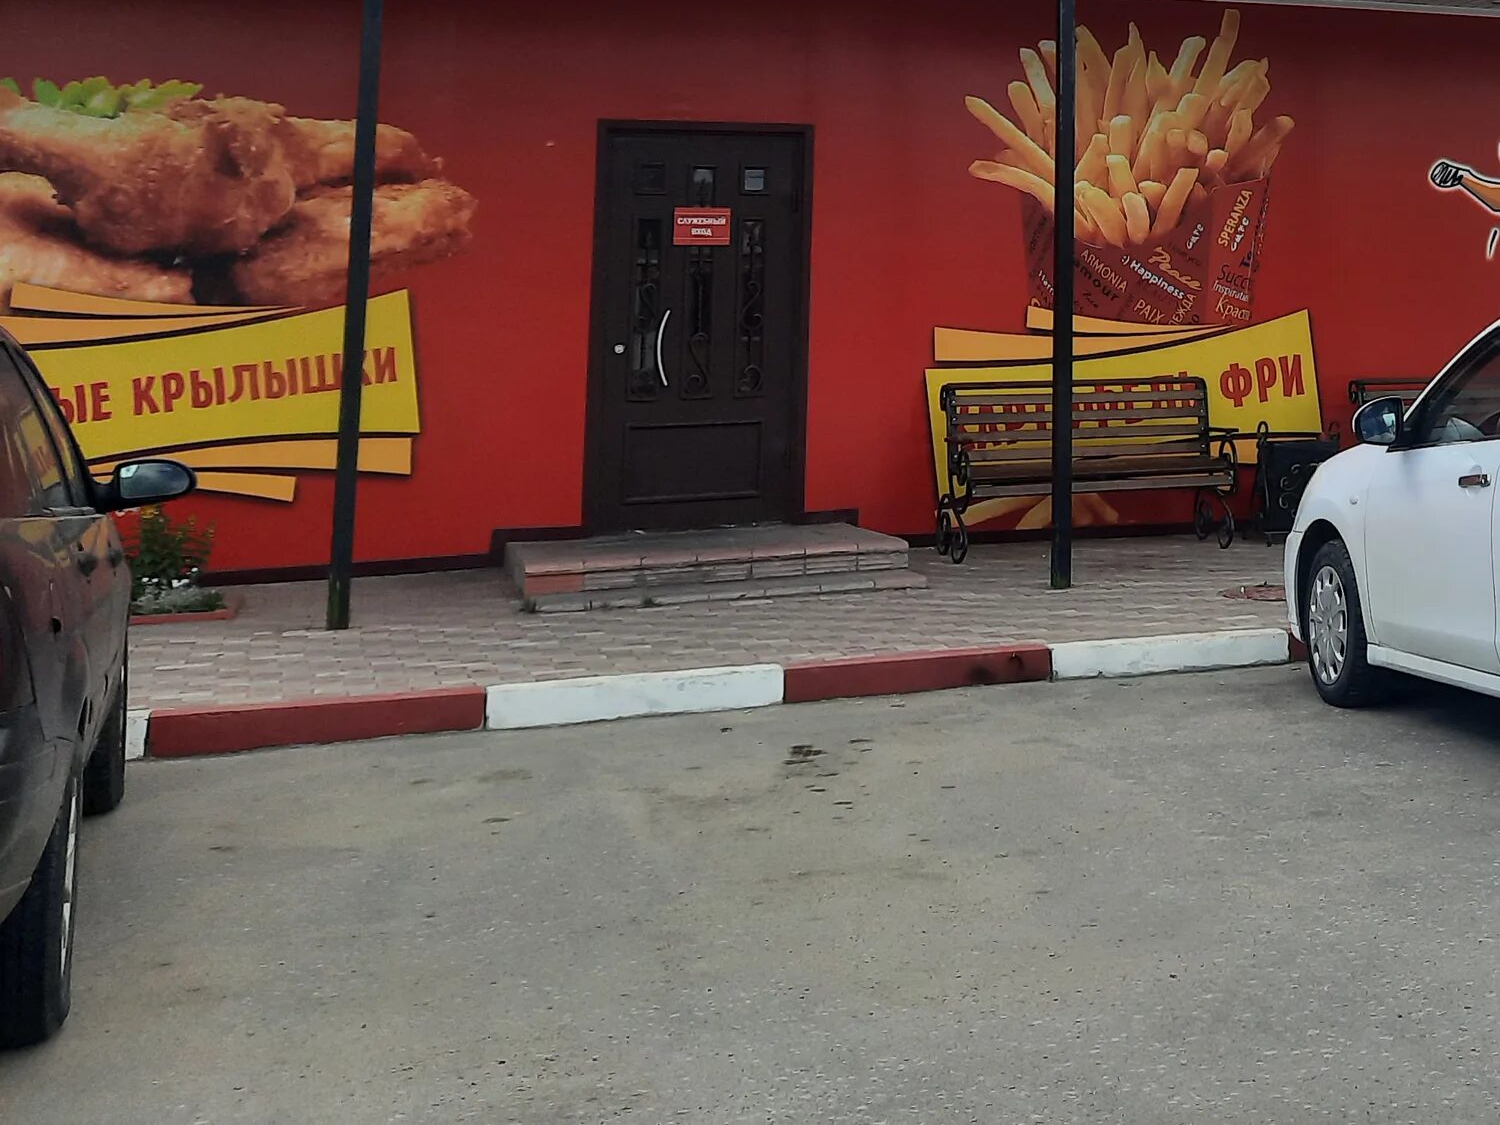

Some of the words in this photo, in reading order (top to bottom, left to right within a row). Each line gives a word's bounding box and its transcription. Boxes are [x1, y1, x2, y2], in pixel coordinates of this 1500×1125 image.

[1218, 189, 1253, 248] SPERANZA
[1080, 249, 1128, 293] ARMONIA
[1219, 354, 1305, 408] ФРИ
